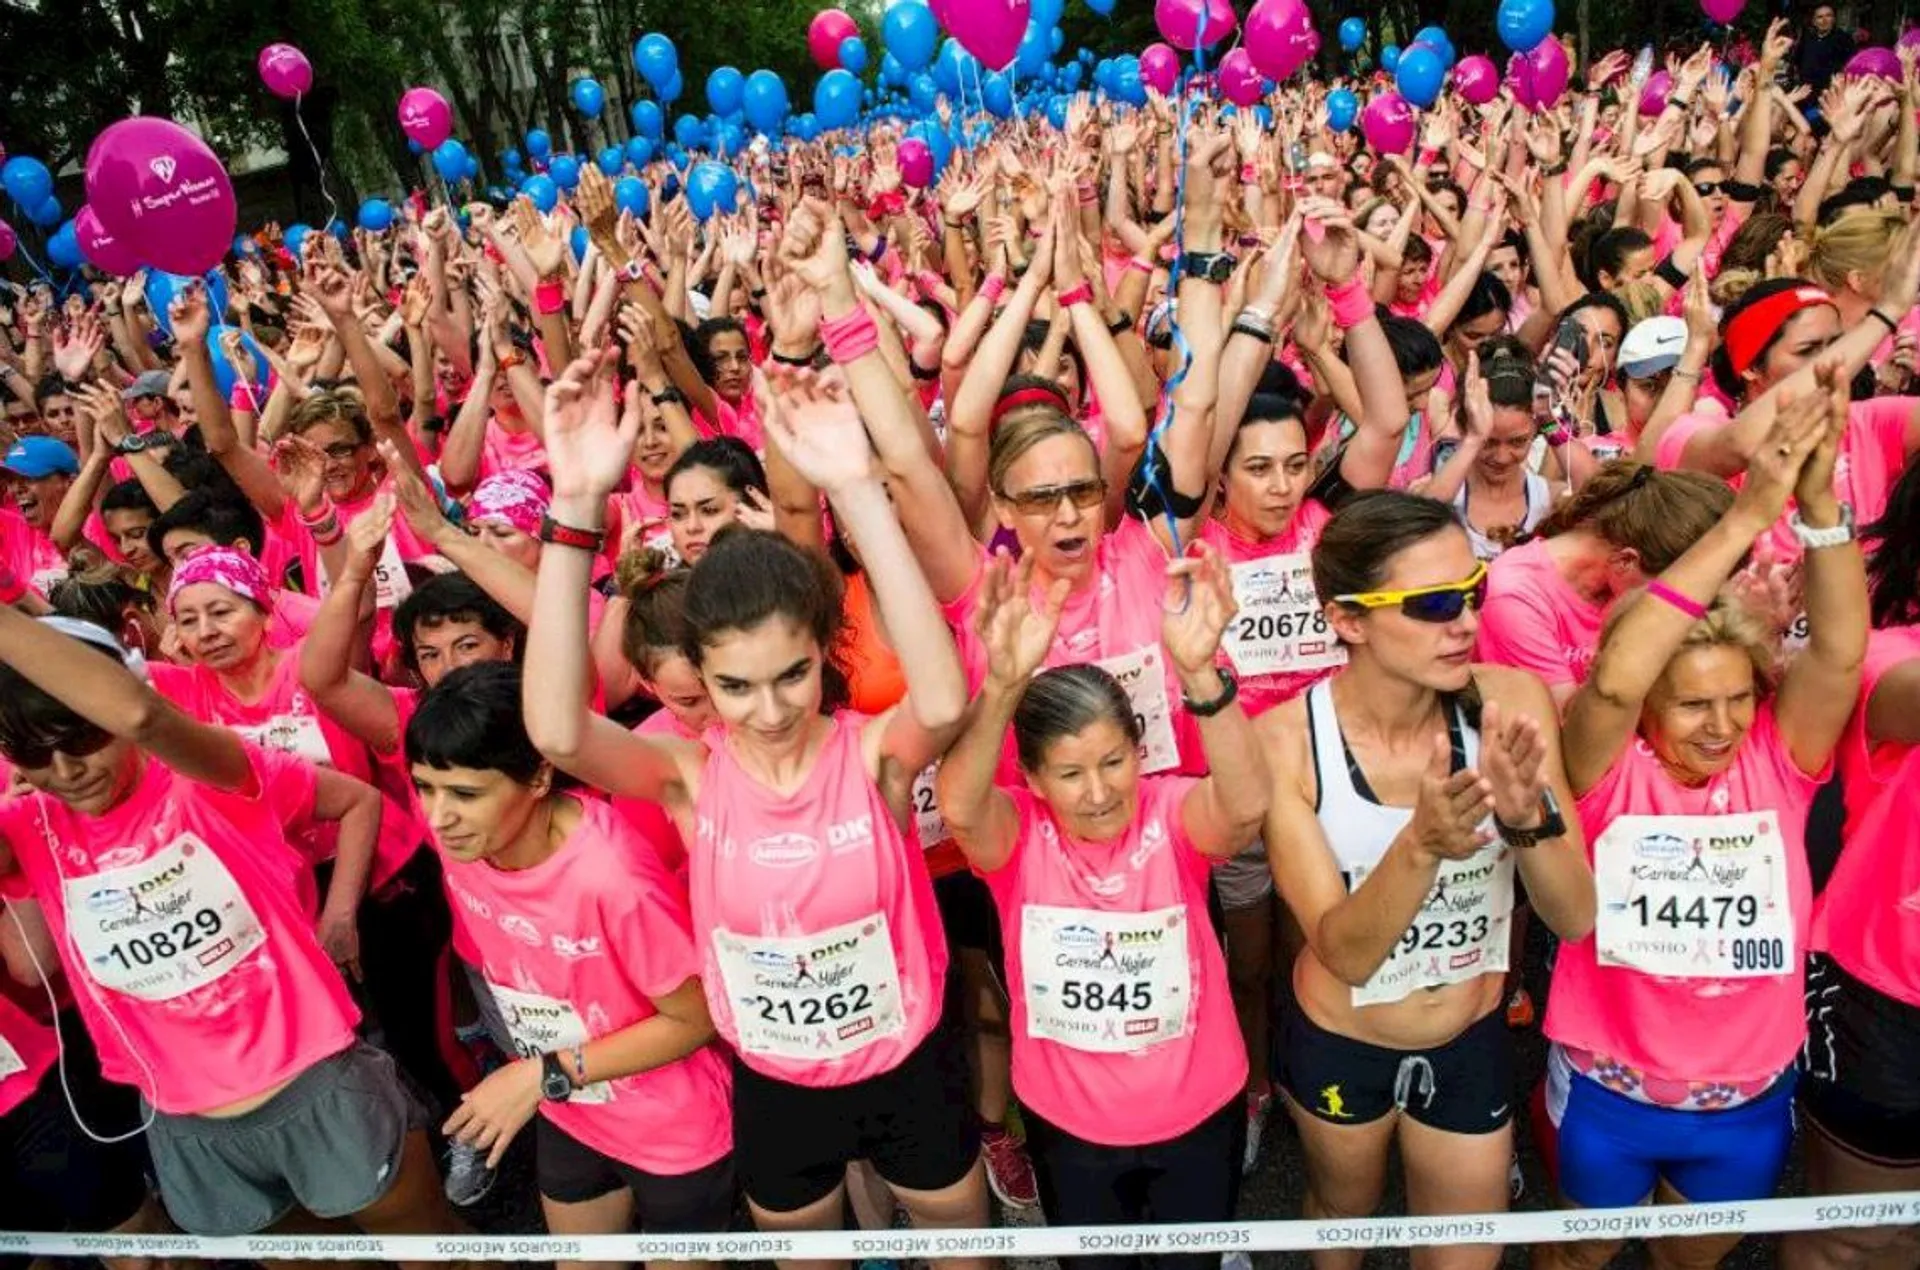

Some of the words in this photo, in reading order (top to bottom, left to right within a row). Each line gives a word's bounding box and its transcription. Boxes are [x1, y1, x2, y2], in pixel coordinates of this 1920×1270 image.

[1239, 609, 1327, 641] 20678
[1709, 835, 1755, 851] DKV
[138, 861, 186, 893] DKV
[1452, 863, 1495, 886] DKV
[1631, 894, 1758, 930] 14479
[109, 907, 223, 970] 10829
[1119, 928, 1164, 944] DKV
[1389, 914, 1490, 960] 9233
[811, 936, 859, 961] DKV
[1732, 937, 1784, 971] 9090
[756, 983, 873, 1026] 21262
[1061, 979, 1153, 1013] 5845
[1562, 1215, 1652, 1235] MÉDICOS
[1657, 1209, 1746, 1228] SEGUROS
[1166, 1229, 1249, 1246] SEGUROS
[1316, 1226, 1402, 1243] MÉDICOS
[1407, 1221, 1495, 1237] SEGUROS
[509, 1242, 581, 1254] SEGUROS
[716, 1240, 792, 1253] SEGUROS
[935, 1236, 1016, 1251] SEGUROS
[1079, 1234, 1162, 1251] MÉDICOS
